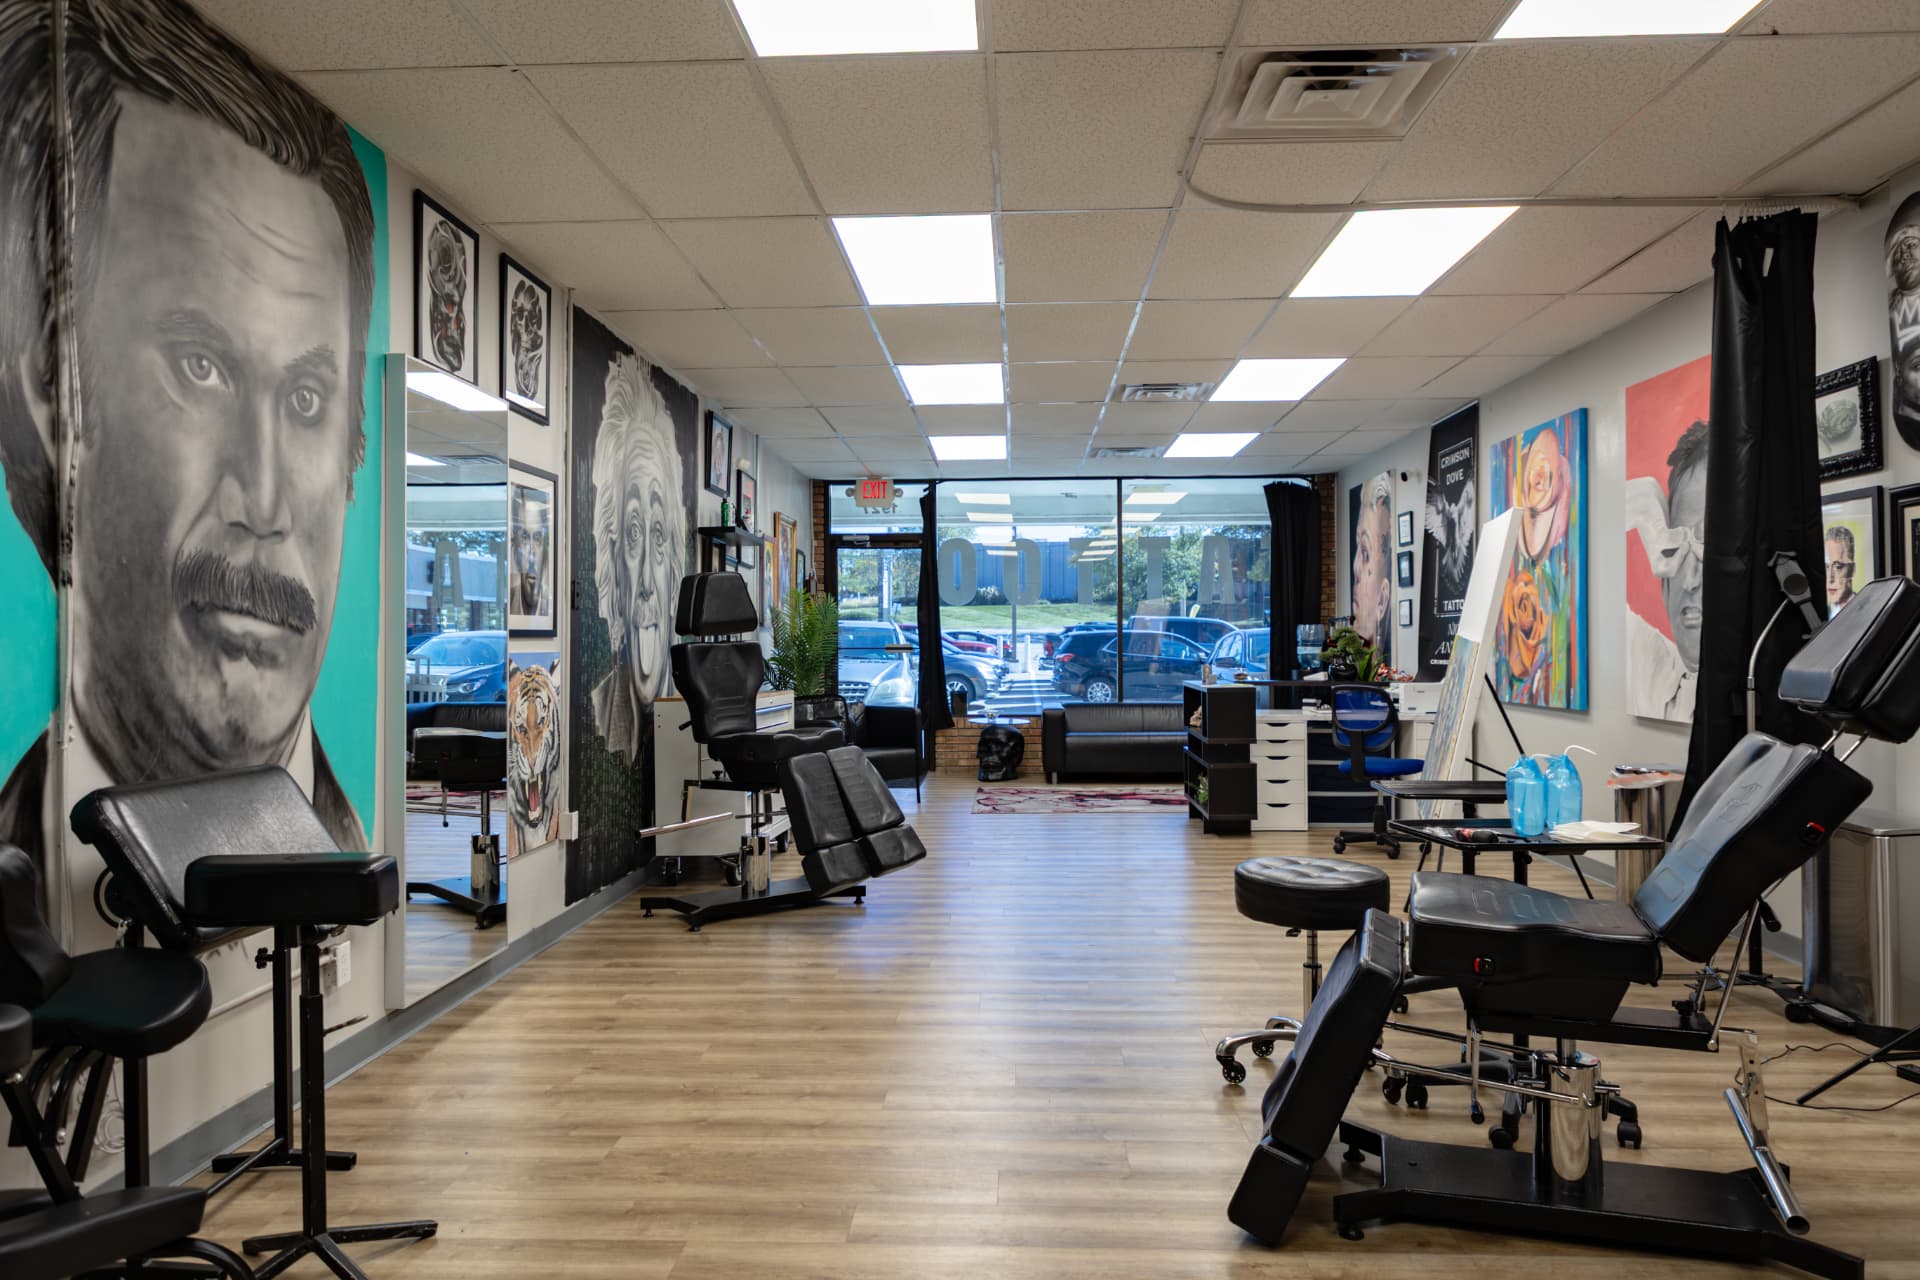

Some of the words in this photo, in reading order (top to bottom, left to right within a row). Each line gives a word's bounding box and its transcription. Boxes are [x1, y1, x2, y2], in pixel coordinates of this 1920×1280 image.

[1441, 447, 1470, 469] CRIMSON
[1446, 468, 1464, 486] DOVE
[862, 481, 887, 499] EXIT
[1443, 599, 1465, 612] TATTO
